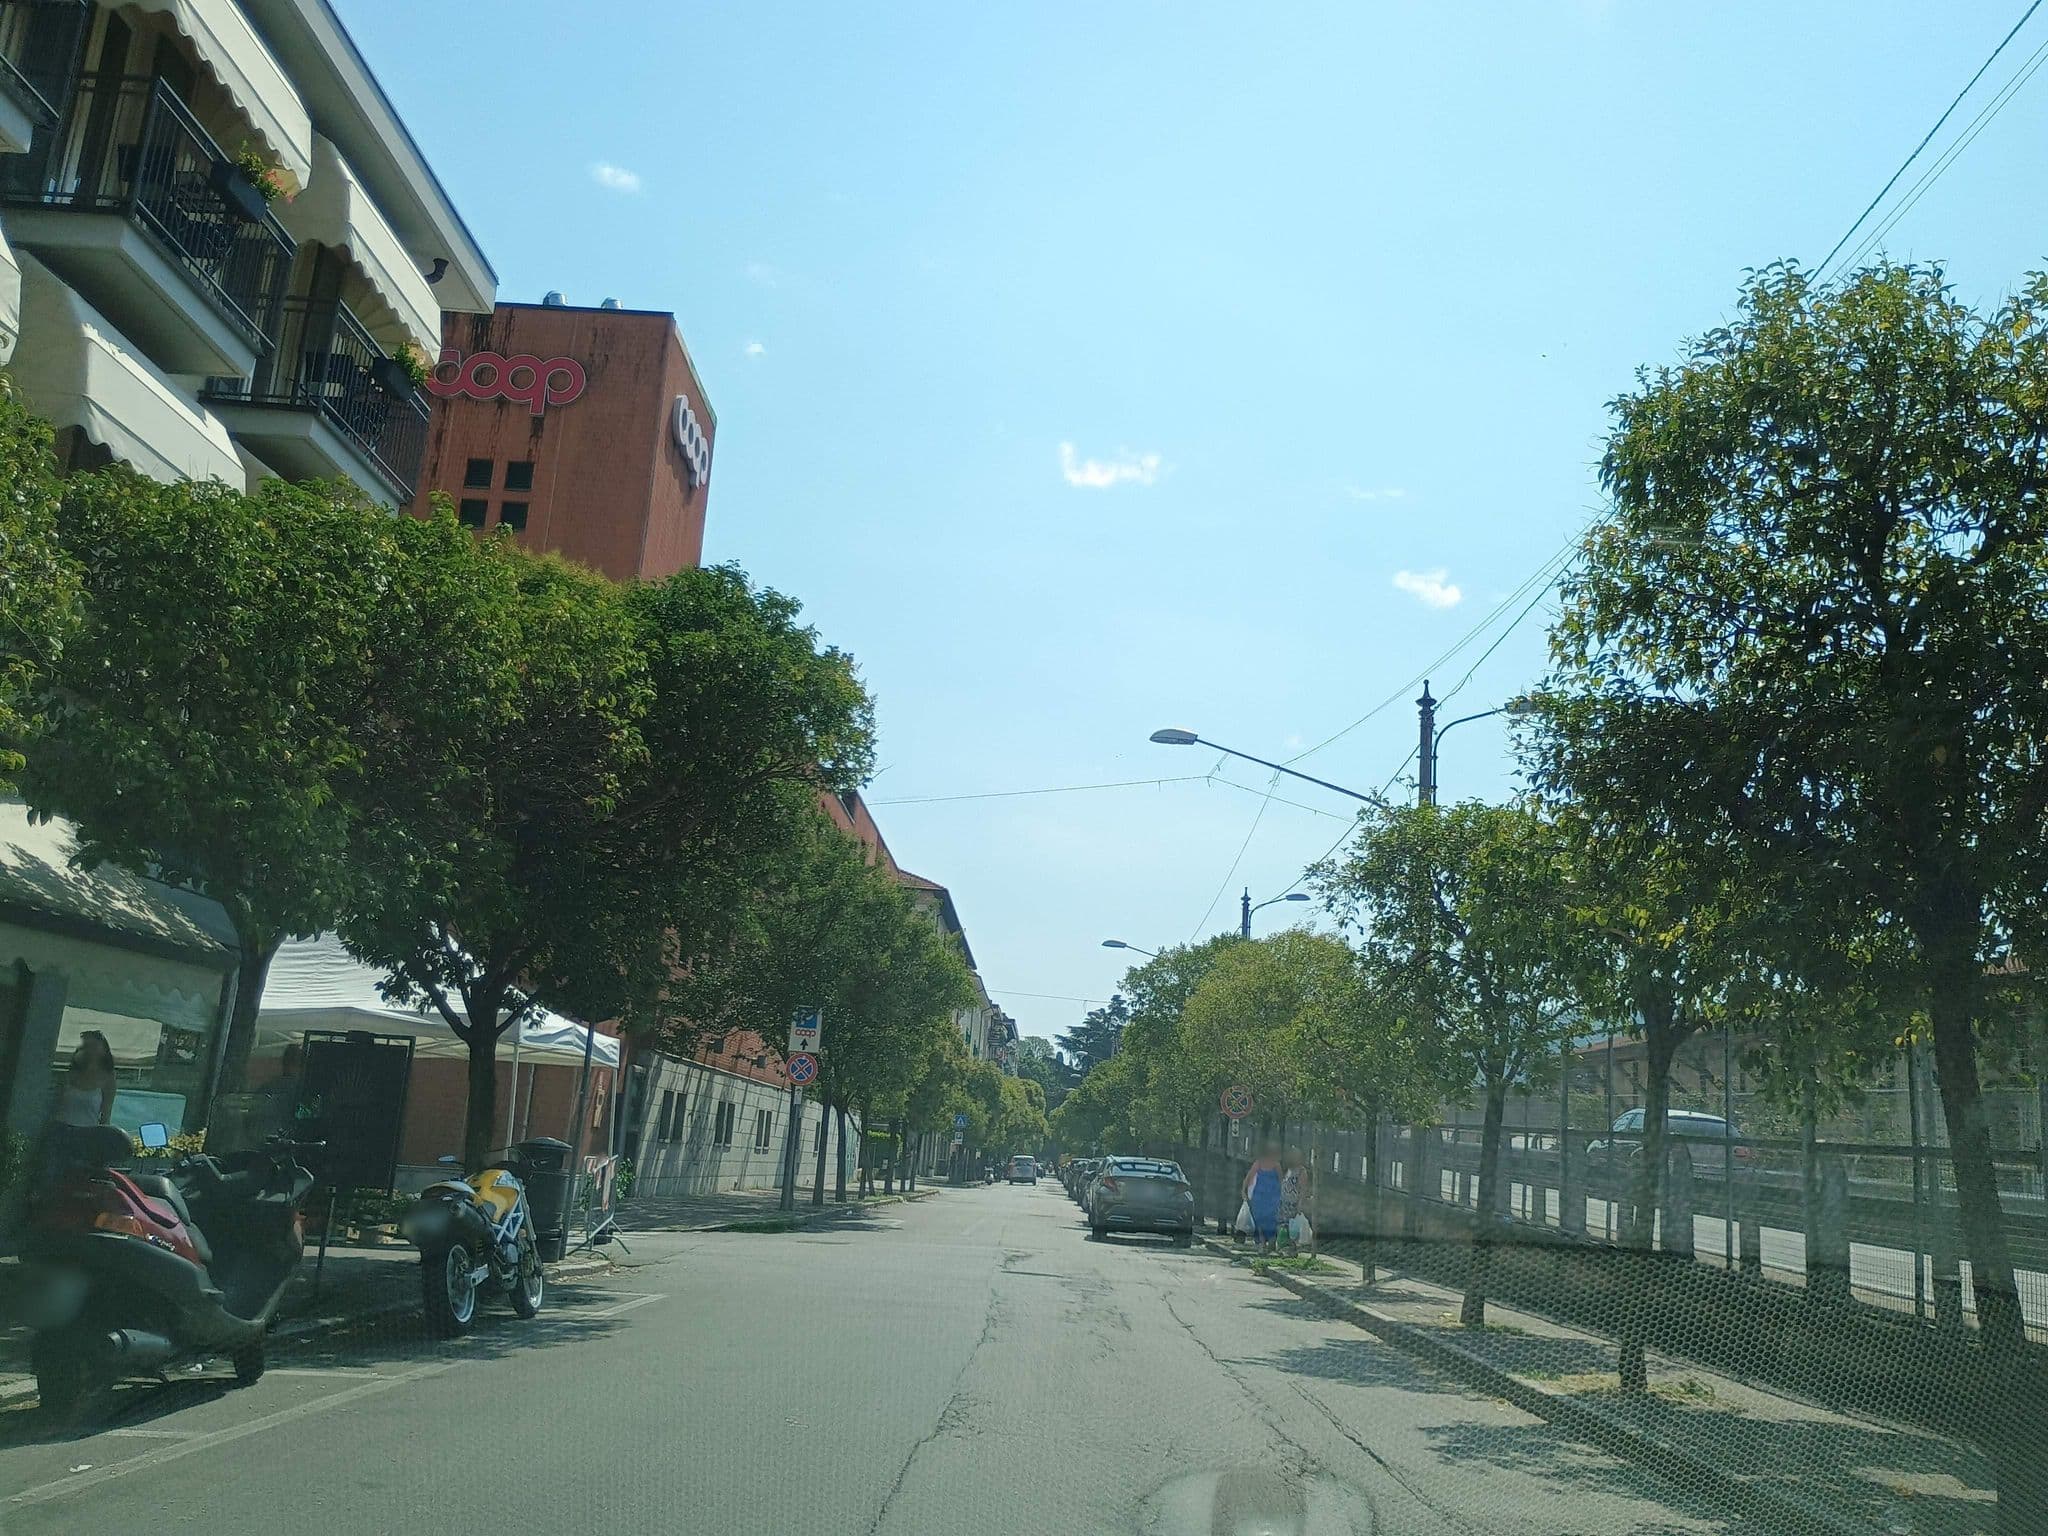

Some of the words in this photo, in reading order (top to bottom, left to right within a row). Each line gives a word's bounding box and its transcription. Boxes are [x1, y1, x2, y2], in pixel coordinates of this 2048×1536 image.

[424, 349, 586, 415] coop
[673, 394, 709, 489] coop
[795, 1029, 816, 1038] coop
